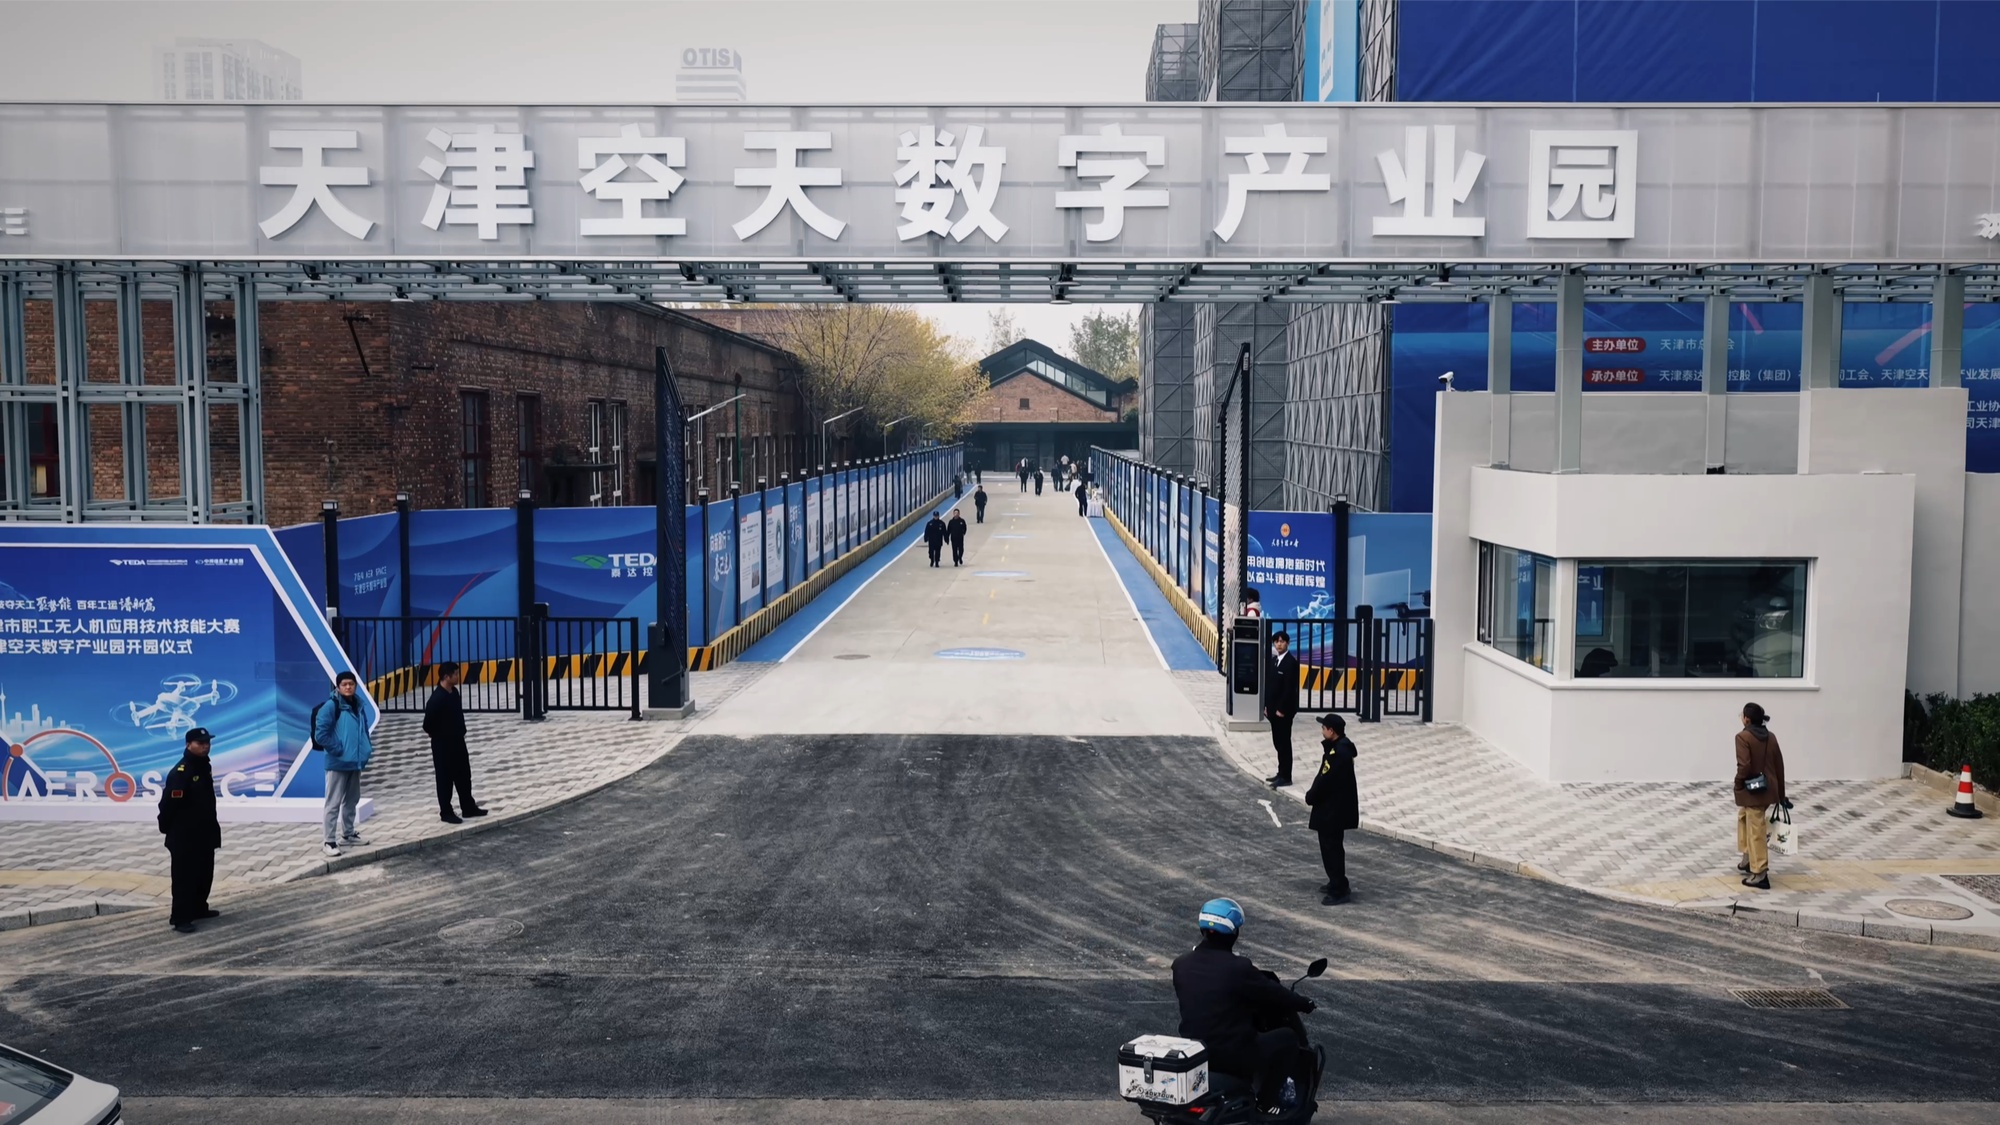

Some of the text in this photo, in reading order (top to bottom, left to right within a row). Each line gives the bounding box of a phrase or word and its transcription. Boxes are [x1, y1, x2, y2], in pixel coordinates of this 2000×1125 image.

[683, 48, 731, 66] OTIS
[259, 122, 1639, 243] 天津空天数字产业园
[1592, 338, 1735, 351] 主办单位 天津市总会
[1591, 370, 1639, 382] 承办单位
[608, 552, 658, 567] TED
[0, 618, 240, 635] 市职工无人机应用技术技能大赛
[17, 769, 277, 802] AEROSCE
